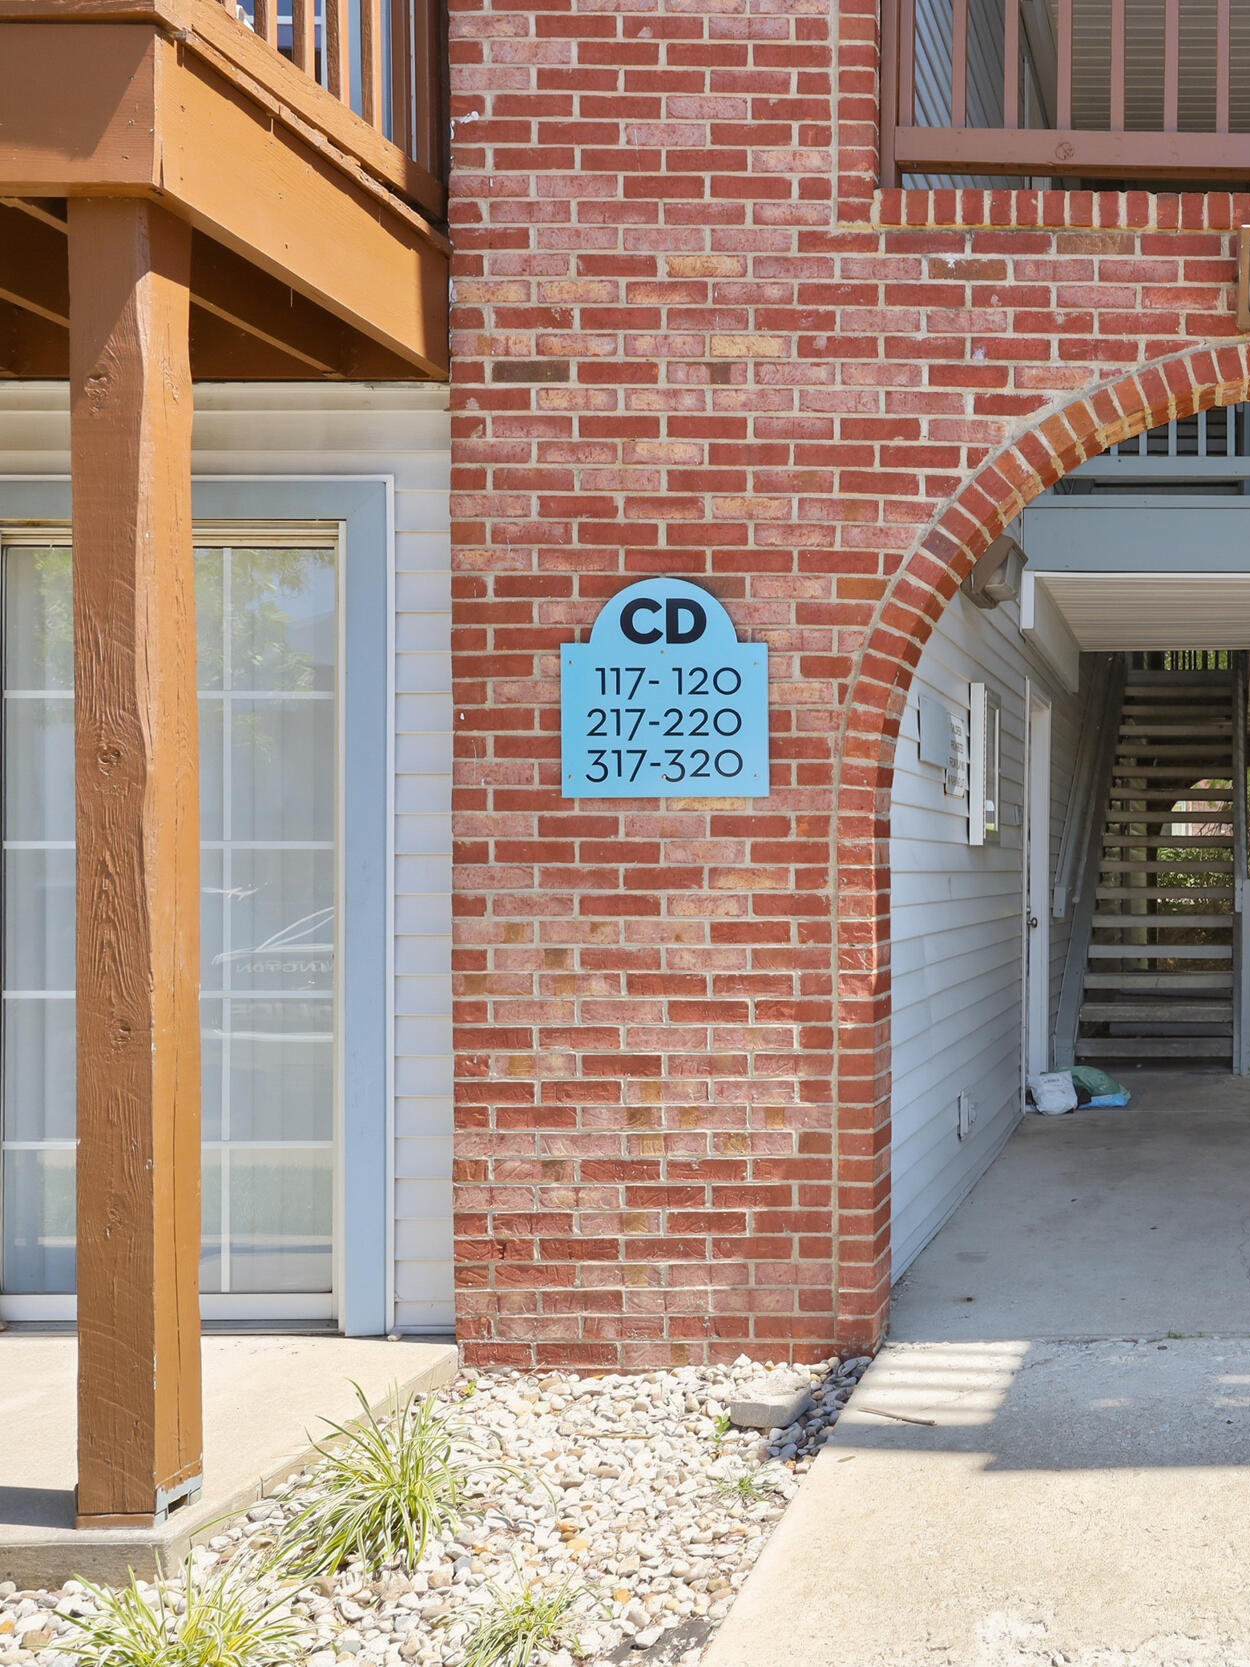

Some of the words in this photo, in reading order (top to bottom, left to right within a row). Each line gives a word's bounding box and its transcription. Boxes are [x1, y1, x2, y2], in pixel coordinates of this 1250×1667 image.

[619, 597, 707, 645] CD
[586, 708, 742, 742] 217-220
[585, 749, 743, 783] 317-320
